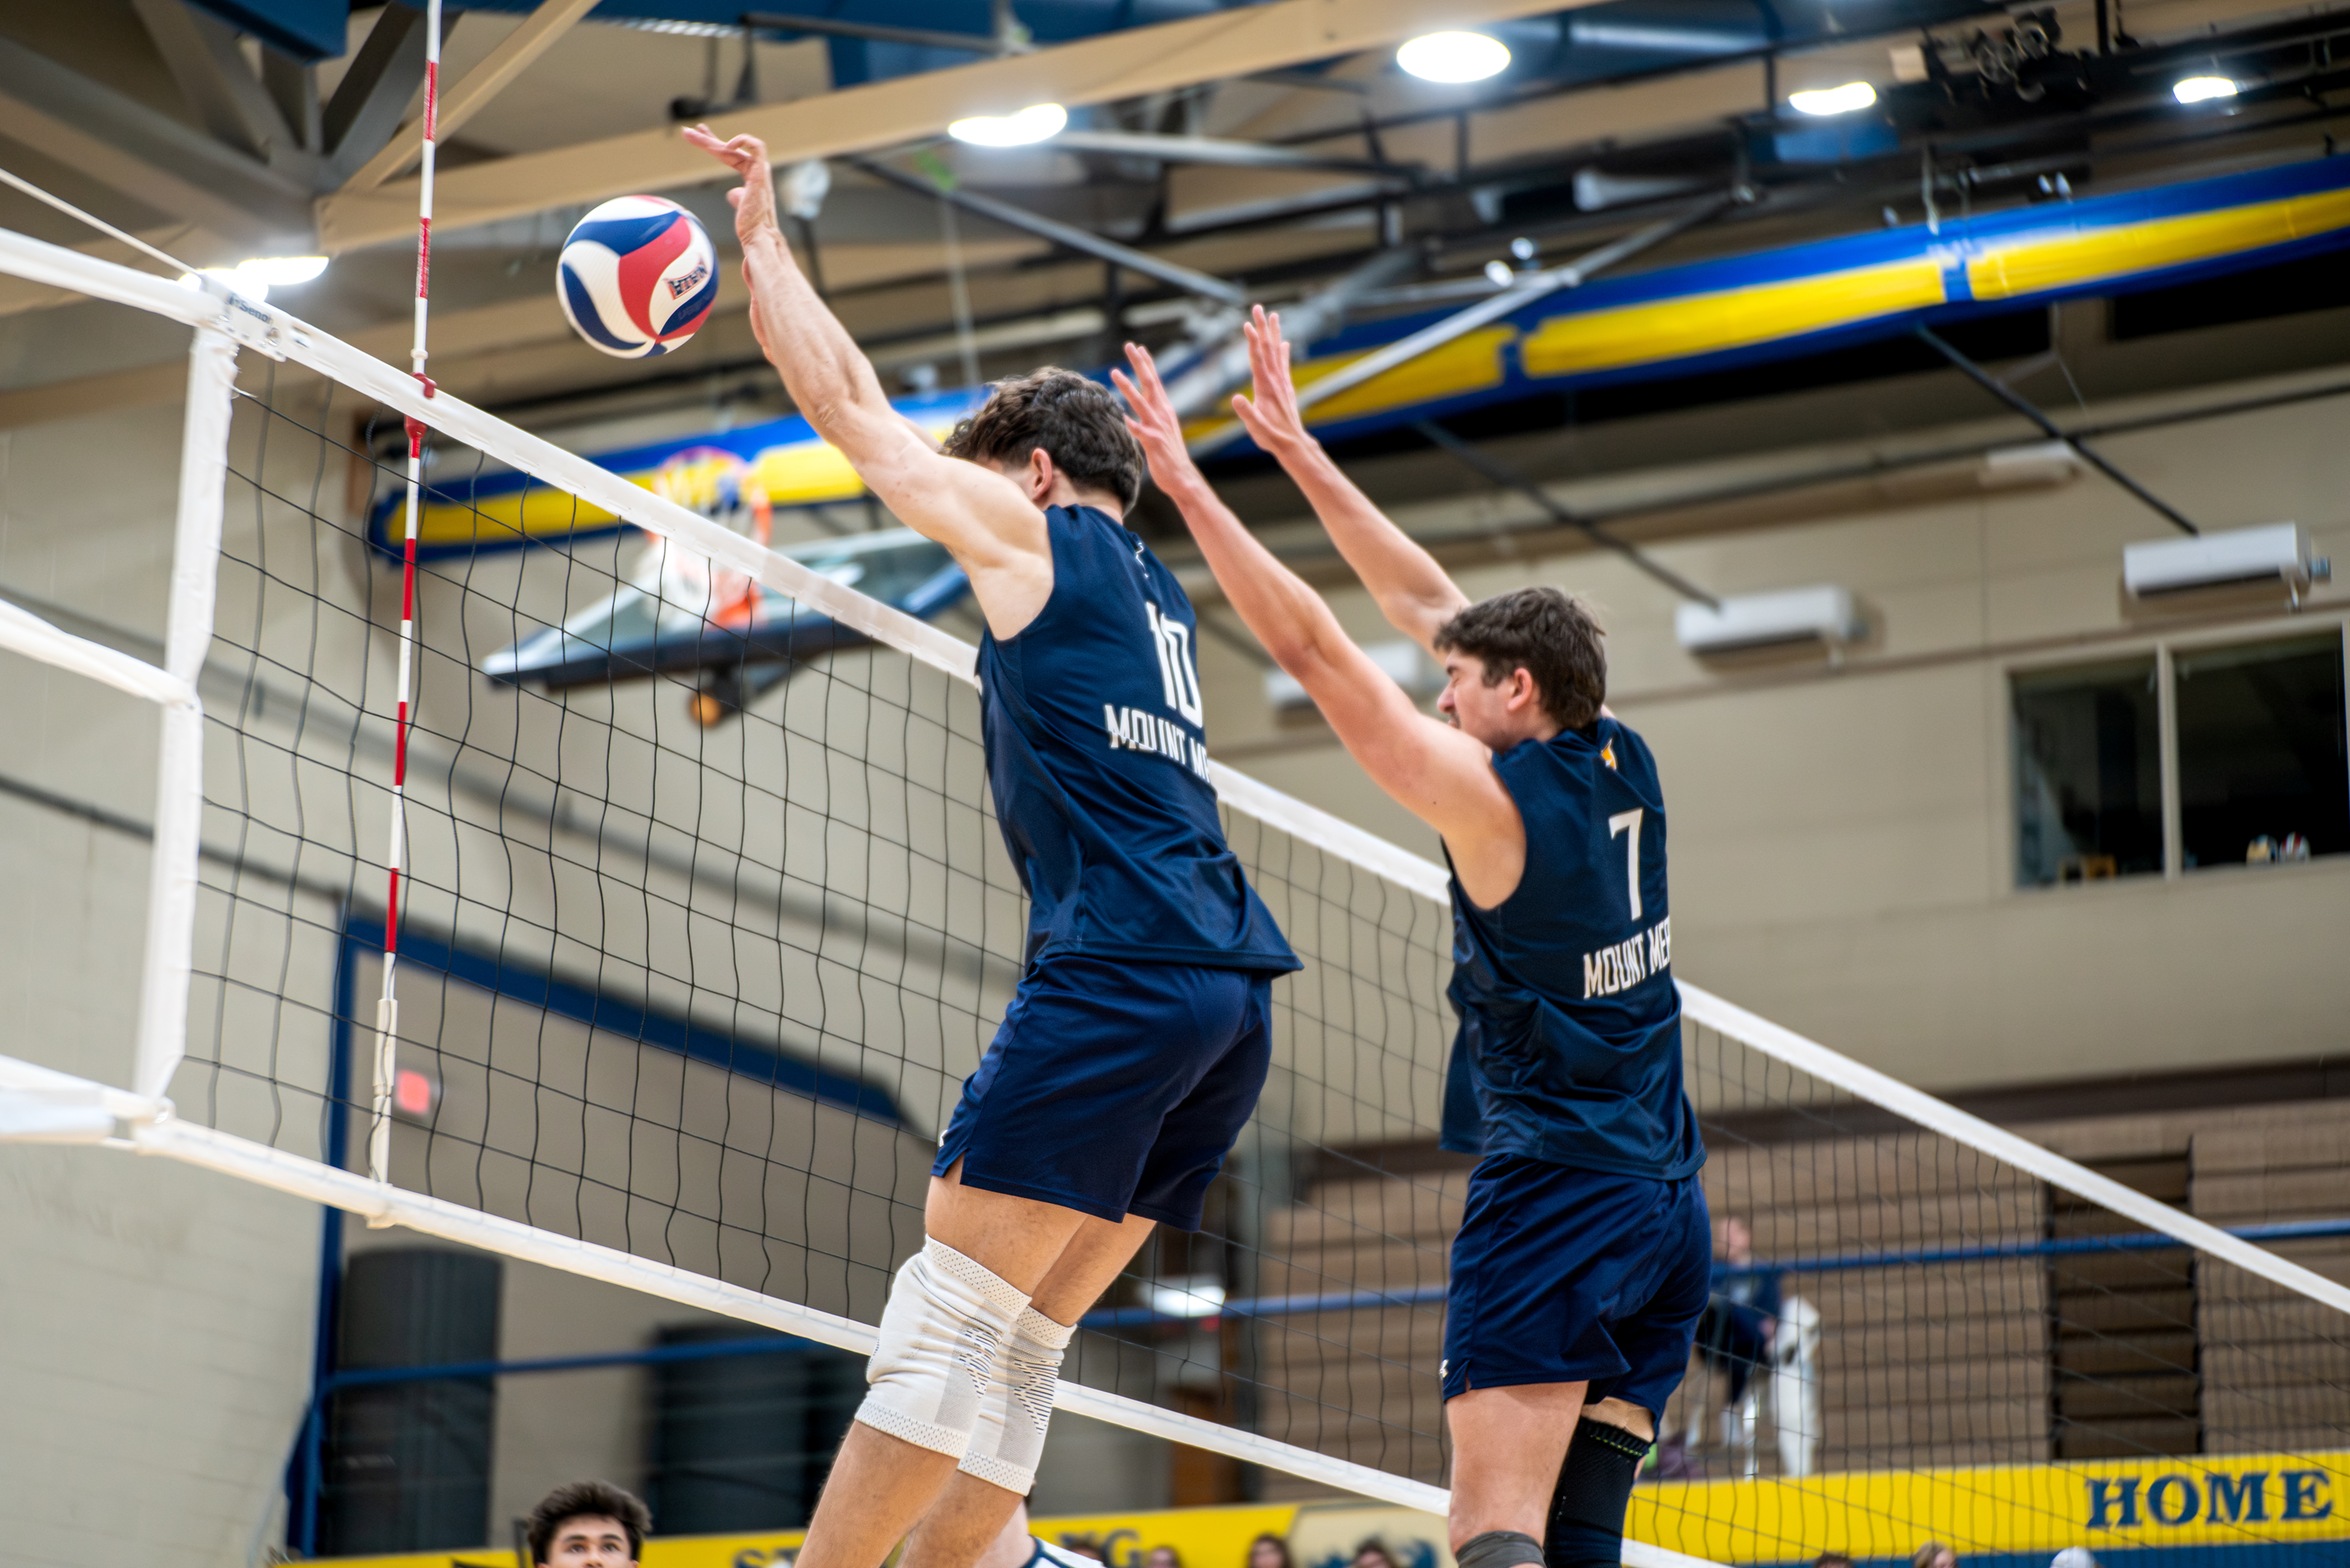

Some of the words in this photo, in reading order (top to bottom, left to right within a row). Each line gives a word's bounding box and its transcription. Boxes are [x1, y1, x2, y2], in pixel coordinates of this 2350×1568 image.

[1145, 601, 1204, 729] 10
[1104, 703, 1187, 766] MOUNT
[1608, 807, 1644, 922] 7
[1583, 932, 1647, 1000] MOUNT
[2085, 1469, 2333, 1530] HOME
